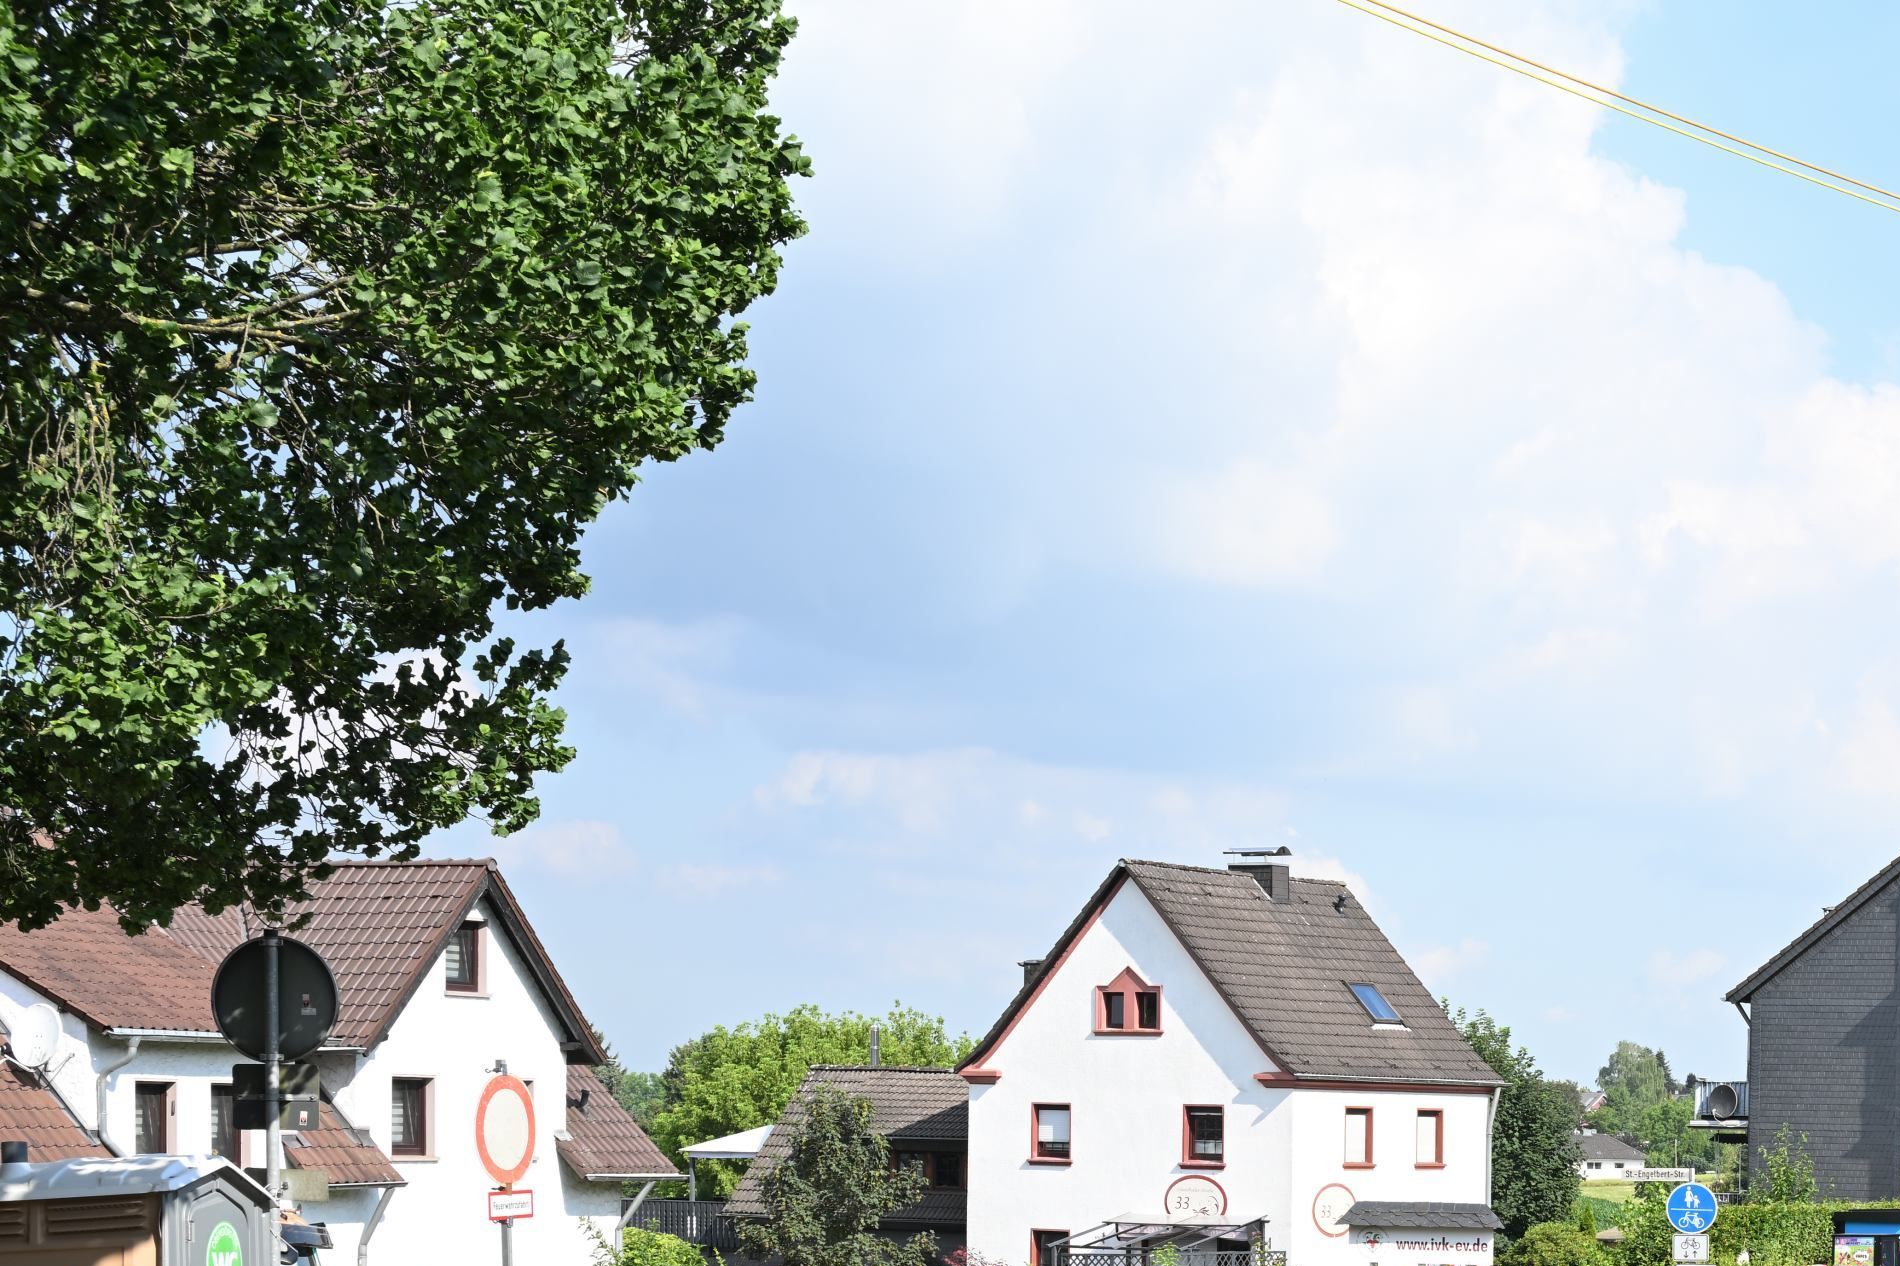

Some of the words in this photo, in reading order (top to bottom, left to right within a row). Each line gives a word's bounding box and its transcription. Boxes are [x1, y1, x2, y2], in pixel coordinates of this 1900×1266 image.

[1625, 1170, 1686, 1180] St.-Engelbert-Str.
[1174, 1196, 1190, 1209] 33
[1396, 1237, 1488, 1252] www.ivk-ev.de
